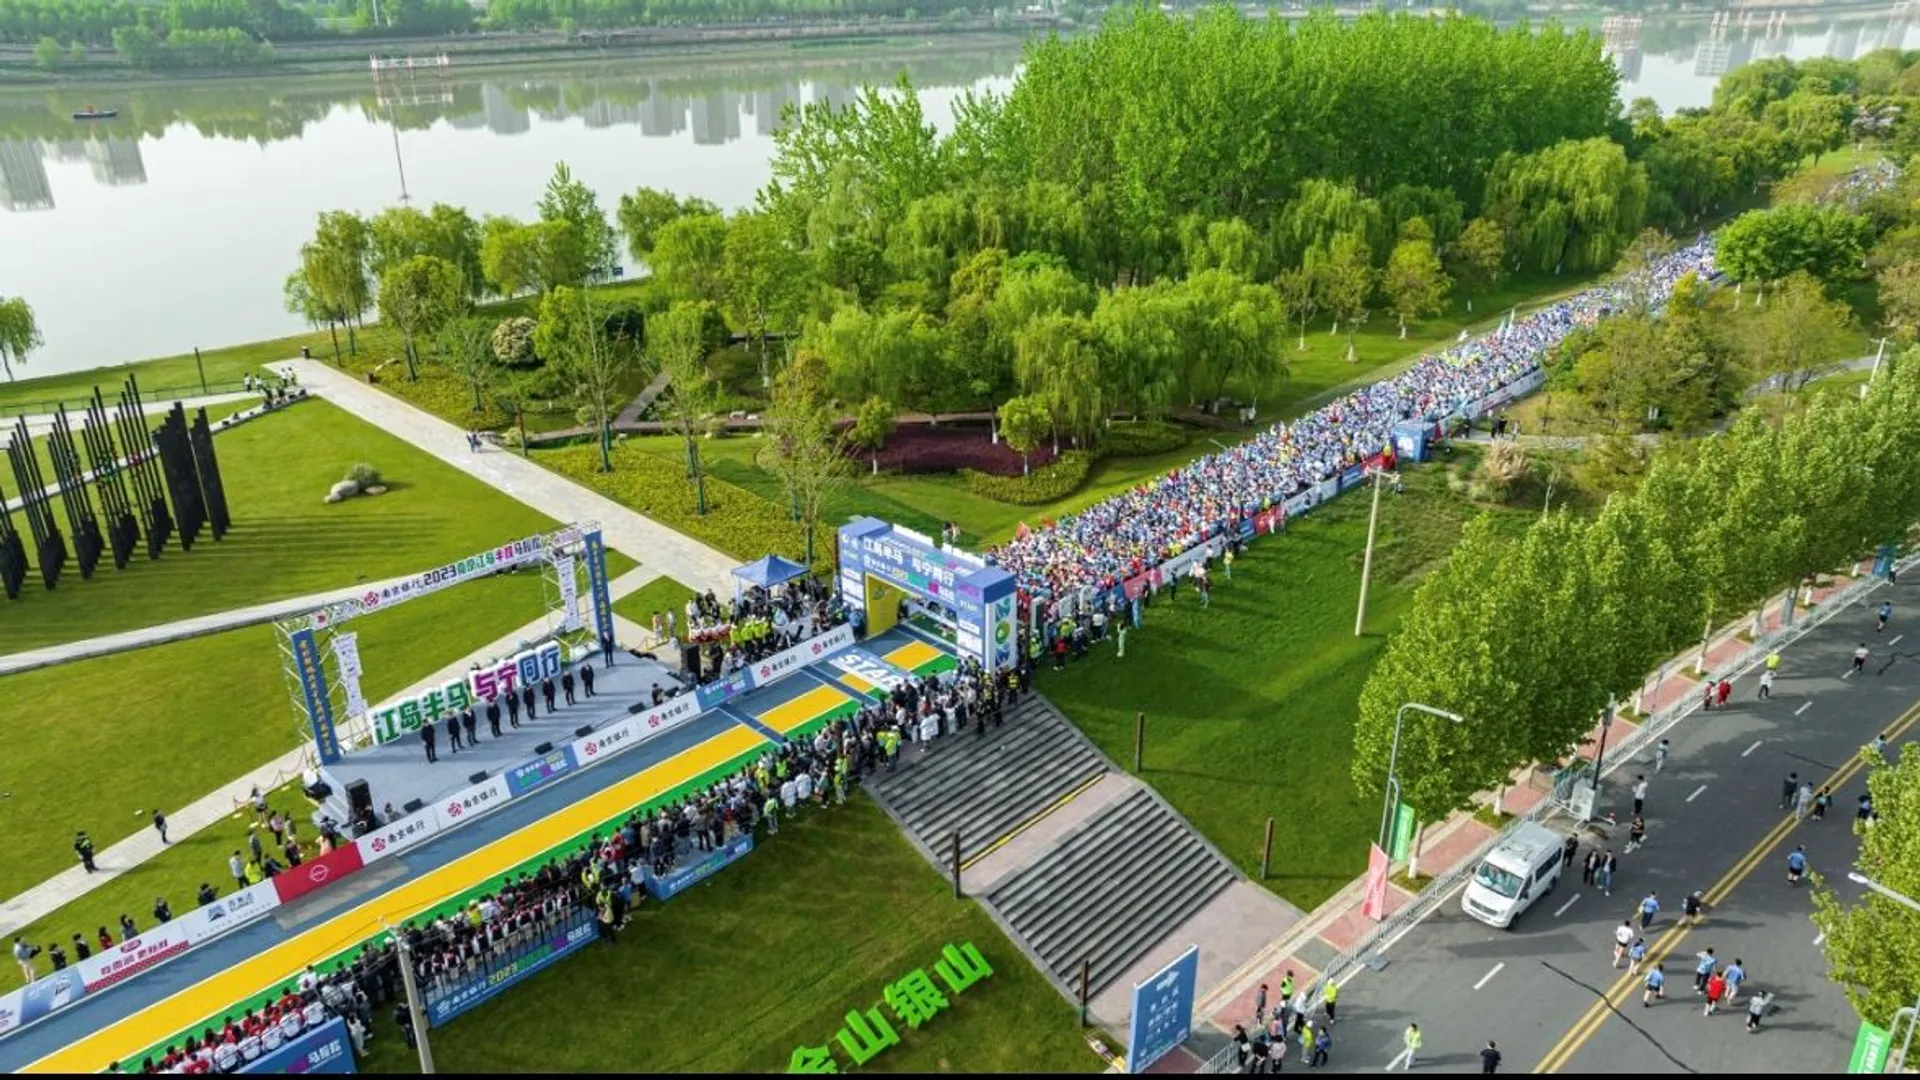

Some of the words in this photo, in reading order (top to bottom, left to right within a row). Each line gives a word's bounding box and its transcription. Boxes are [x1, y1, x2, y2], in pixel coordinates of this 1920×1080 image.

[844, 654, 908, 692] STAR
[598, 729, 630, 749] 南京银行
[463, 788, 498, 809] 南京银行
[388, 819, 425, 844] 南京银行
